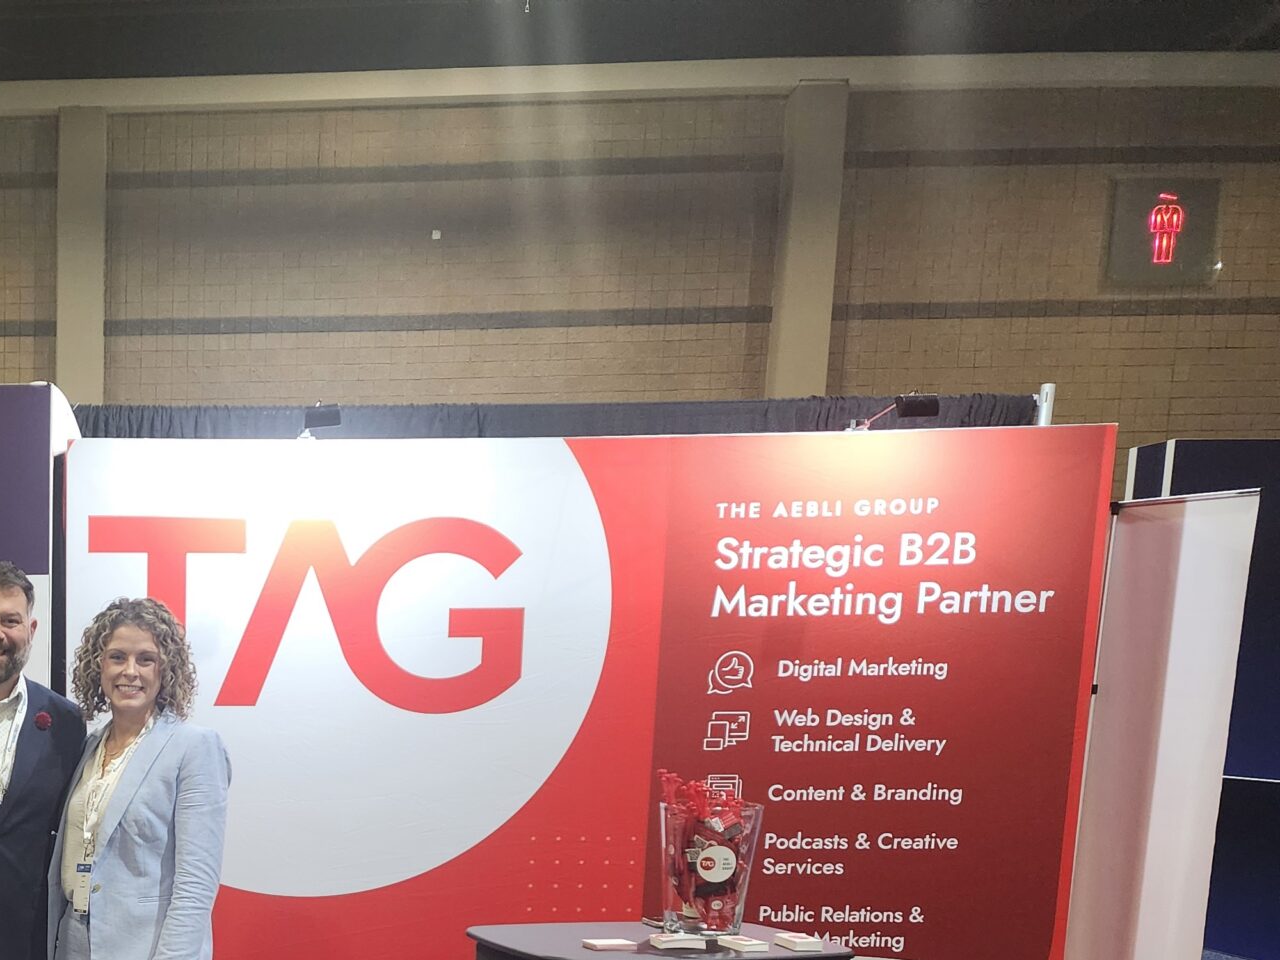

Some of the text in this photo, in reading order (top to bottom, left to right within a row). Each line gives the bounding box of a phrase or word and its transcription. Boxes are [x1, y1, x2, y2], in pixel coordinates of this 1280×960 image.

[715, 497, 940, 519] THE AEBLI GROUP
[714, 531, 978, 578] Strategic B2B
[710, 580, 1056, 625] Marketing Partner
[87, 515, 526, 715] TAG
[777, 656, 948, 682] Digital Marketing
[773, 707, 916, 730] Web Design &
[770, 733, 947, 756] Technical Delivery
[767, 782, 963, 806] Content & Branding
[764, 832, 959, 850] Podcasts & Creative
[762, 858, 844, 875] Services
[758, 904, 925, 923] Public Relations &
